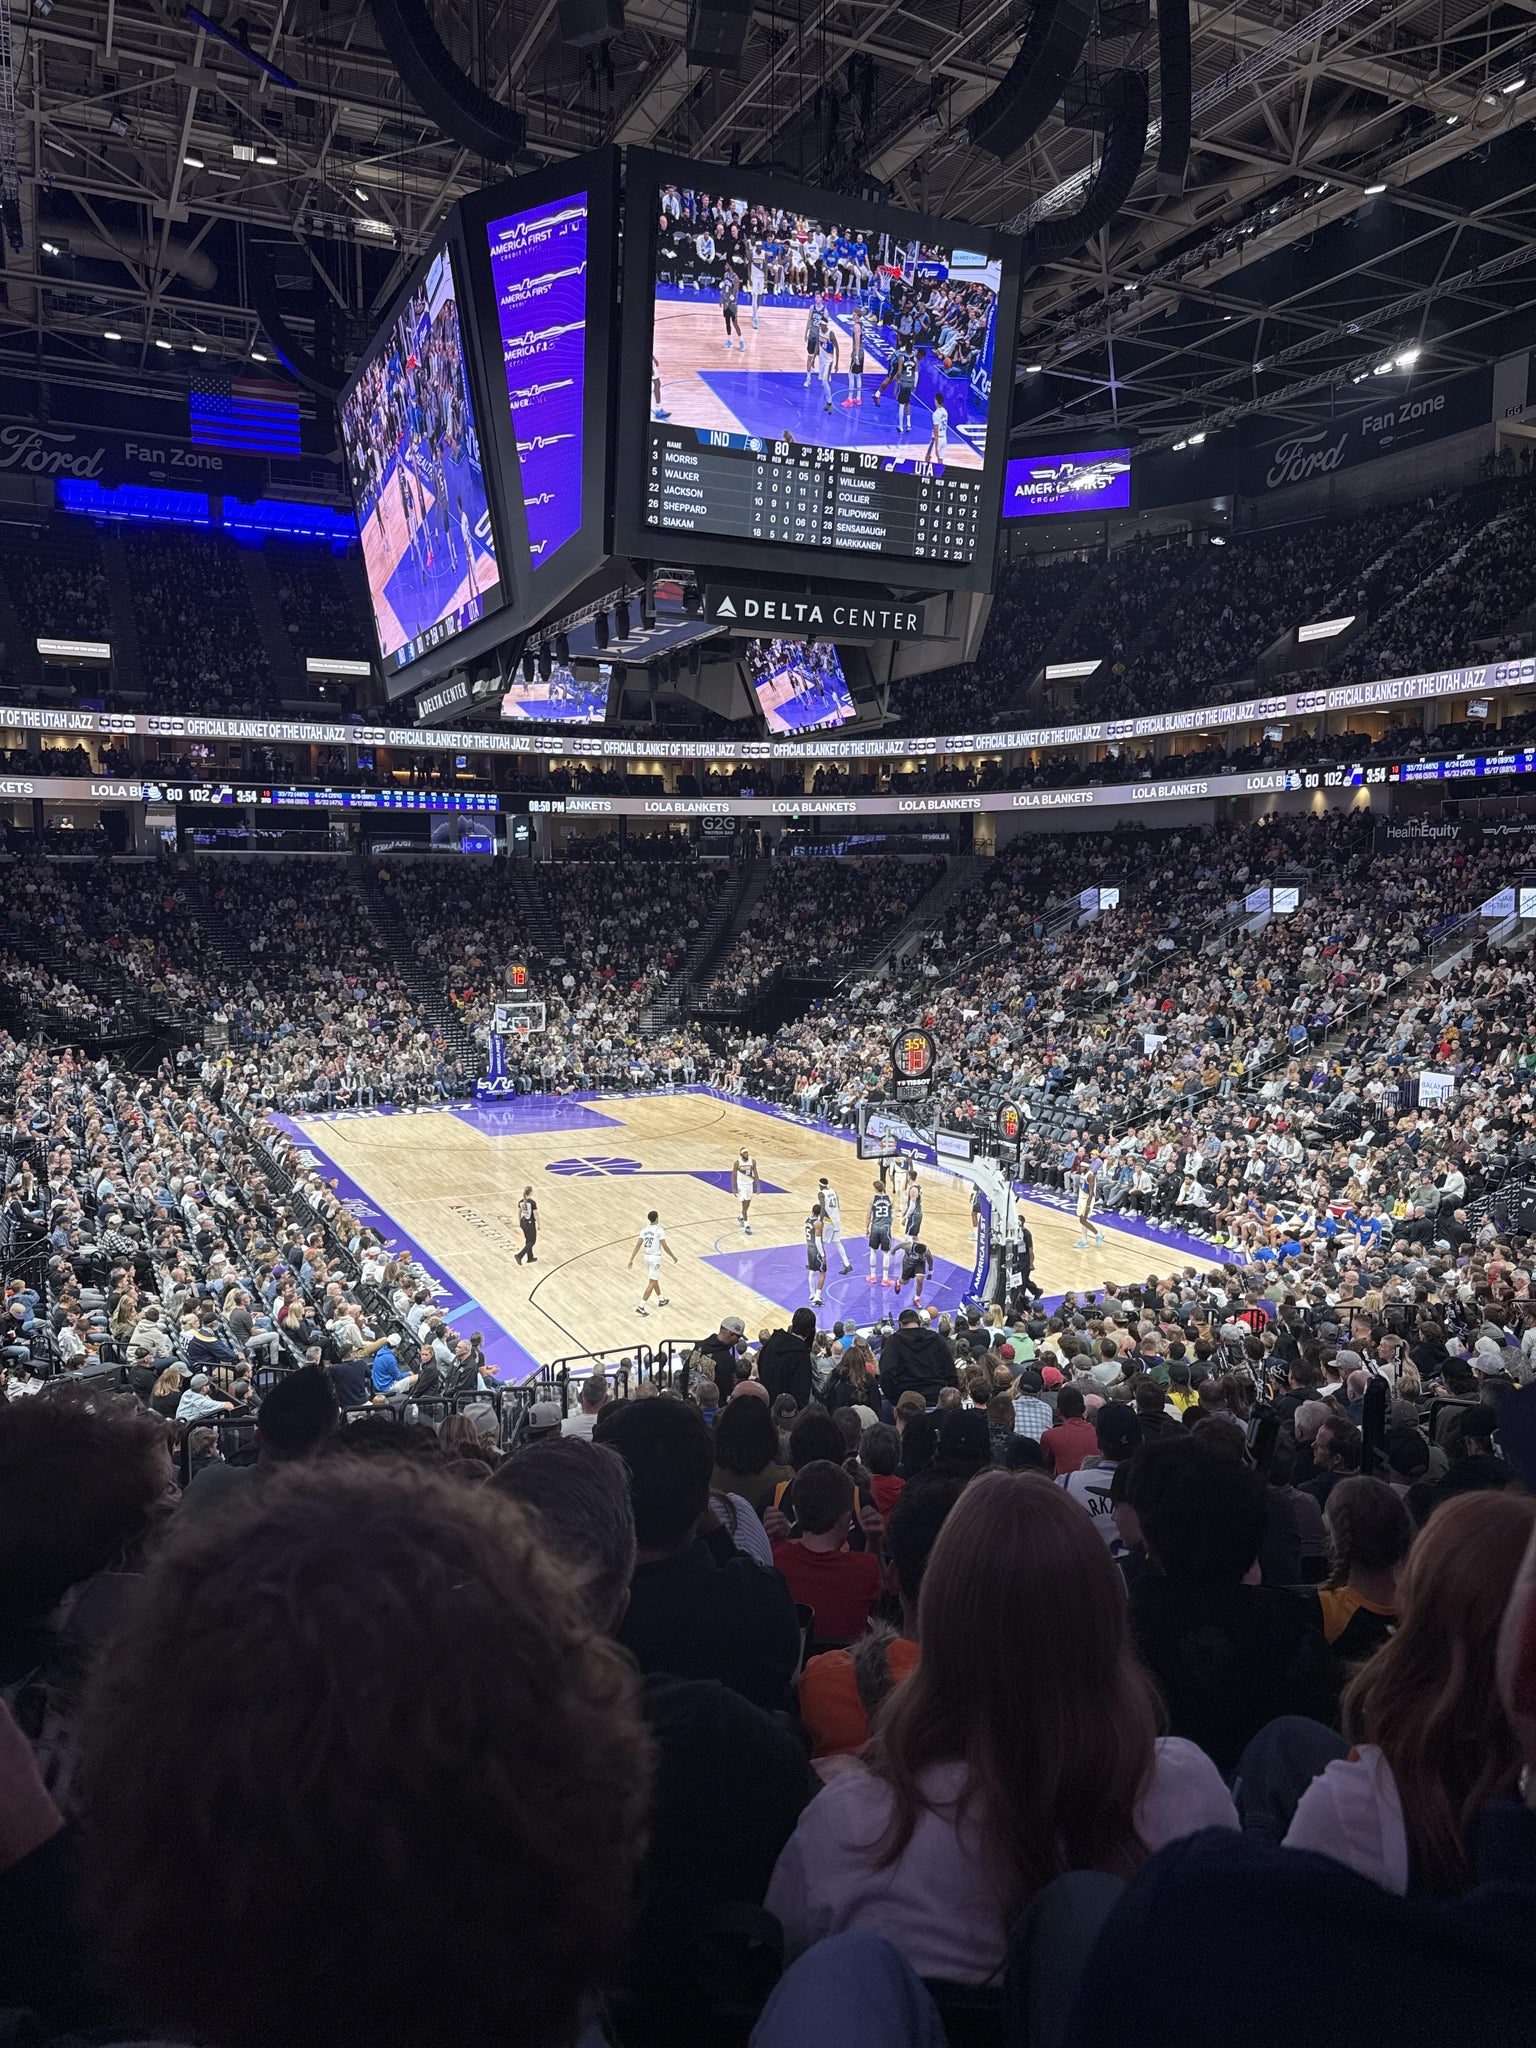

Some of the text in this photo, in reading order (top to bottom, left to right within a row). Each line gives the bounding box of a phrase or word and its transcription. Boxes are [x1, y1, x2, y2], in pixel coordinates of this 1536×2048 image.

[490, 237, 527, 257] AMERICA
[528, 229, 553, 245] FIRST
[500, 283, 553, 306] AMERICA FIRST
[1361, 394, 1445, 436] Fan Zone
[1506, 407, 1521, 417] GG
[710, 431, 730, 447] IND
[0, 425, 106, 478] Ford
[125, 443, 223, 470] Fan Zone
[774, 441, 789, 456] 80
[817, 448, 834, 463] 3:54
[840, 452, 849, 463] 18
[859, 453, 879, 469] 102
[1266, 430, 1349, 488] Ford
[652, 451, 809, 481] 3 MORRIS 05
[914, 461, 934, 477] UTA
[651, 467, 806, 496] 5 WALKER 11
[828, 476, 967, 502] 5 WILLIAMS 10
[648, 483, 806, 511] 22 JACKSON 10 13
[827, 491, 966, 516] 8 COLLIER 10 17
[648, 499, 805, 527] 26 SHEPPARD 06
[824, 506, 965, 531] 22 FILIPOWSKI 12
[647, 515, 805, 541] 43 SIAKAM 18 27
[823, 521, 963, 546] 28 SENSABAUGH 13 10
[822, 536, 963, 560] 23 MARKKANEN 29 23
[744, 598, 917, 631] DELTA CENTER
[1328, 670, 1486, 708] OFFICIAL BLANKET OF THE UTAH JAZZ
[423, 682, 468, 715] DELTA CENTER
[7, 711, 20, 726] OF
[21, 711, 40, 727] THE
[41, 713, 67, 729] UTAH
[69, 715, 93, 730] JAZZ
[1136, 704, 1254, 735] OFFICIAL BLANKET OF THE UTAH JAZZ
[188, 720, 345, 741] OFFICIAL BLANKET OF THE UTAH JAZZ
[975, 726, 1101, 750] OFFICIAL BLANKET OF THE UTAH JAZZ
[389, 731, 530, 750] OFFICIAL BLANKET OF THE UTAH JAZZ
[604, 743, 735, 757] OFFICIAL BLANKET OF THE UTAH JAZZ
[773, 741, 904, 757] OFFICIAL BLANKET OF THE UTAH JAZZ
[1305, 774, 1319, 787] 80
[1323, 772, 1341, 786] 102
[1366, 768, 1386, 783] 3:54
[91, 785, 127, 797] LOLA
[1132, 783, 1208, 799] LOLA BLANKETS
[1246, 778, 1274, 790] LOLA
[166, 789, 183, 801] 80
[189, 790, 210, 802] 102
[236, 790, 257, 803] 3:54
[1013, 791, 1094, 807] LOLA BLANKETS
[528, 800, 565, 813] 08:50 PM
[645, 802, 730, 813] LOLA BLANKETS
[772, 802, 857, 813] LOLA BLANKETS
[899, 798, 981, 811] LOLA BLANKETS
[702, 816, 735, 830] G2G
[1386, 824, 1459, 840] HealthEquity
[904, 1037, 926, 1051] 3:54
[907, 1078, 931, 1087] TISSOT
[875, 1206, 889, 1218] 23
[644, 1237, 654, 1248] 26
[974, 1245, 985, 1290] AMERICA
